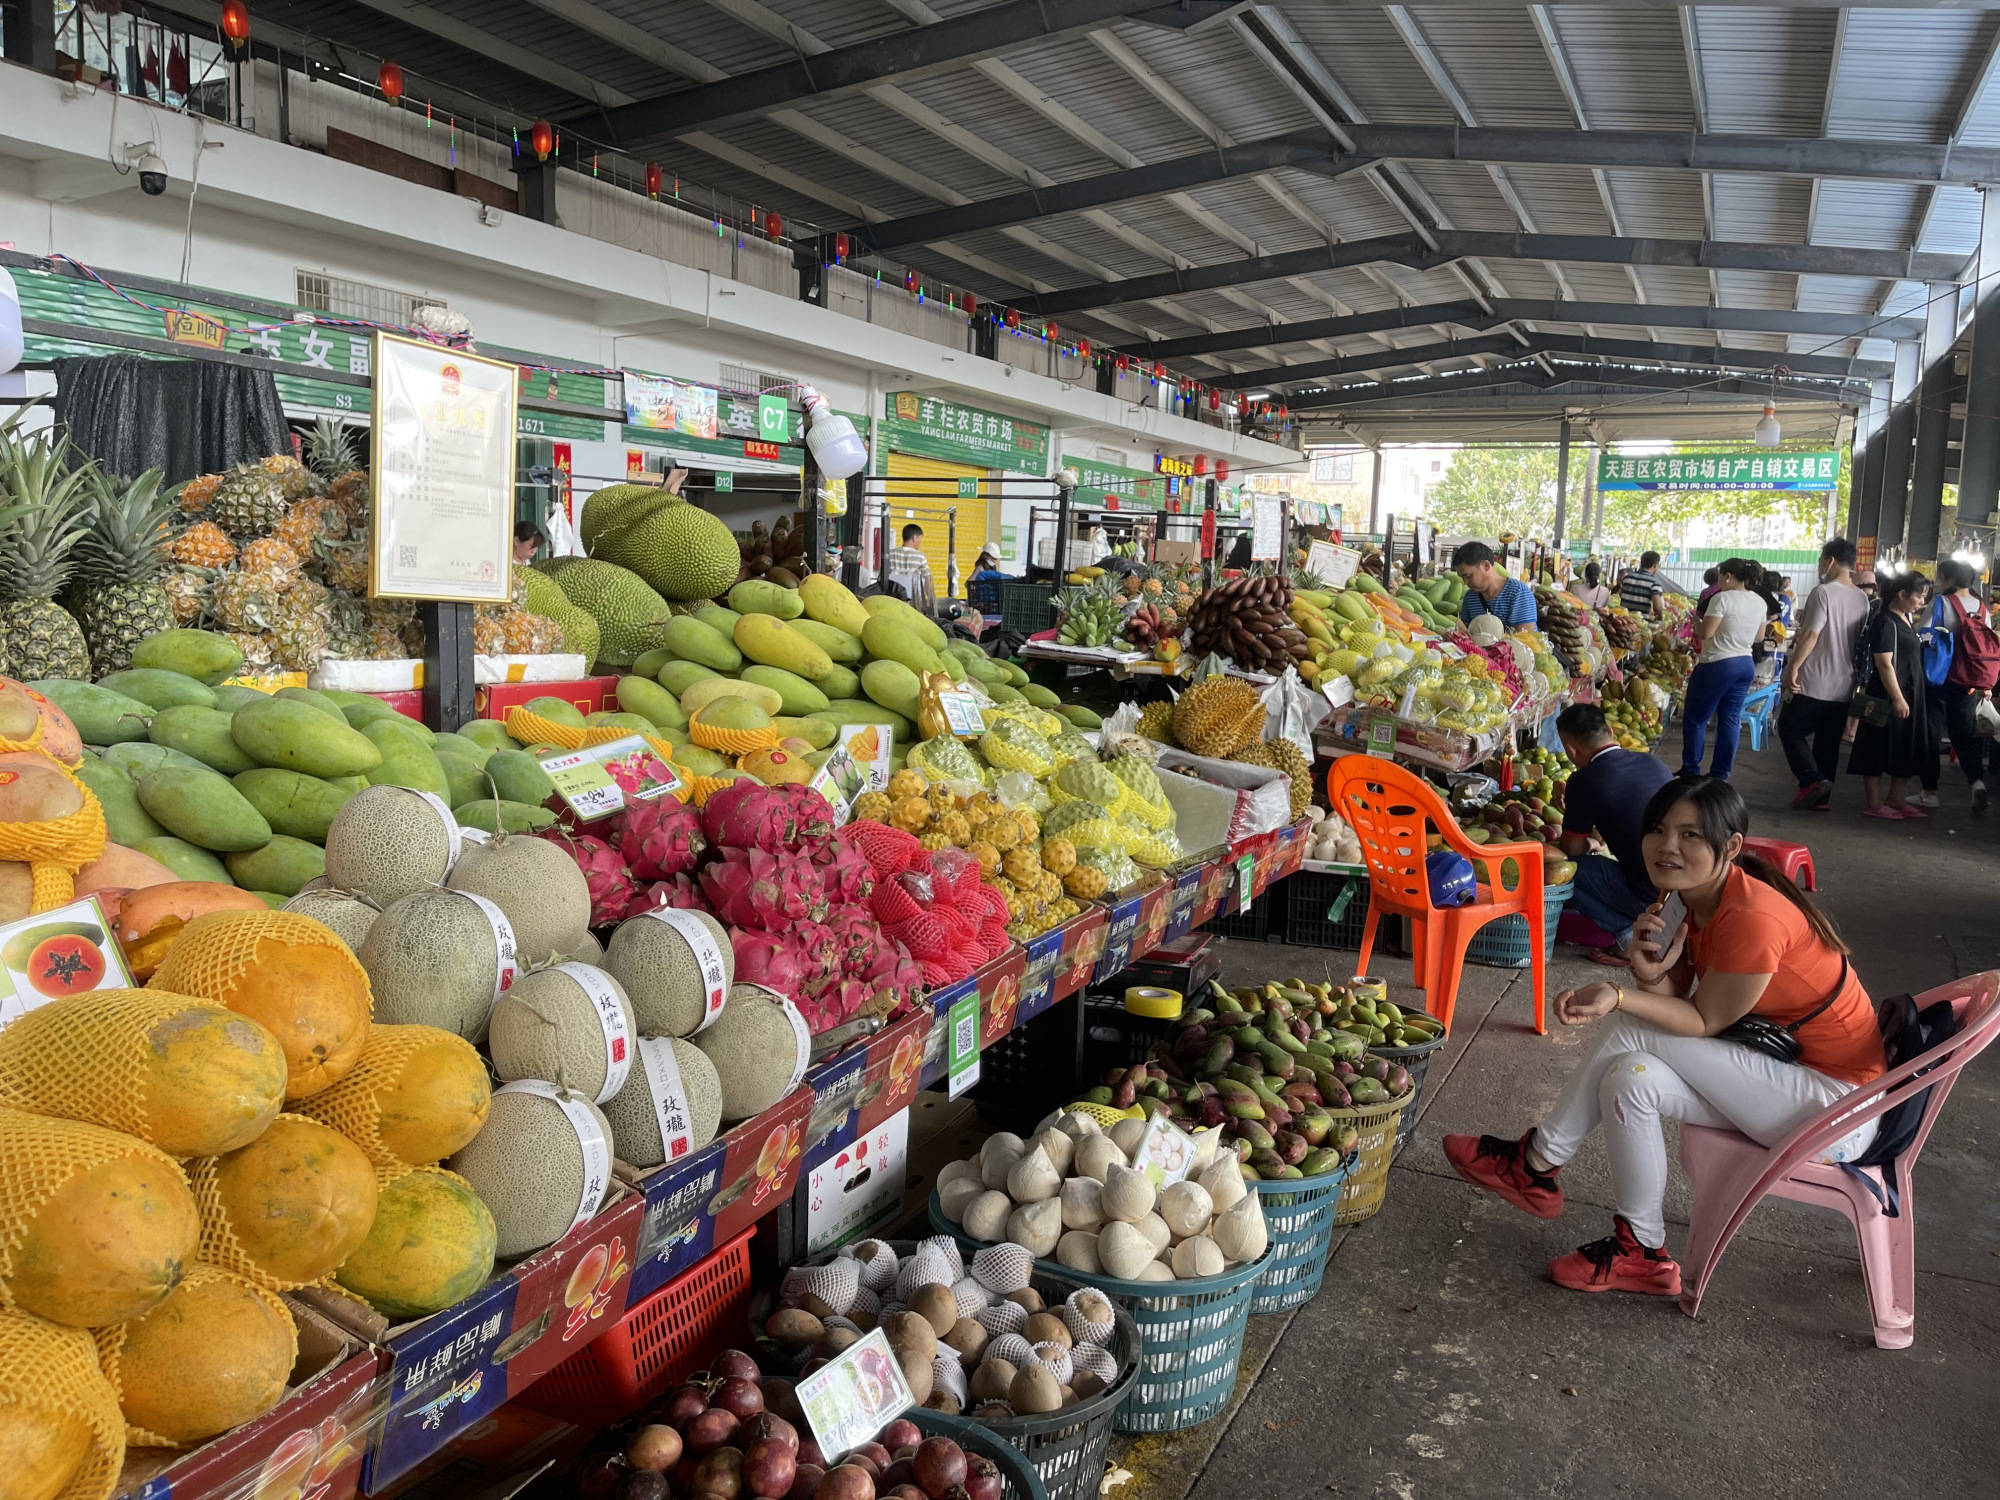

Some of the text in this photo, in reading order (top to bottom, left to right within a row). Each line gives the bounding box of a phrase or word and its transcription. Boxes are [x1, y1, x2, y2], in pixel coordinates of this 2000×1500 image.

[763, 406, 785, 431] C7
[921, 401, 1012, 441] 羊栏农贸市场
[986, 441, 1012, 452] MARKET
[1605, 457, 1833, 479] 天涯区农贸市场自产自销交易区
[716, 476, 730, 487] D12
[959, 482, 975, 493] D11
[661, 1095, 687, 1133] 玫瓏
[878, 1132, 889, 1173] 轻放
[811, 1172, 823, 1212] 小心
